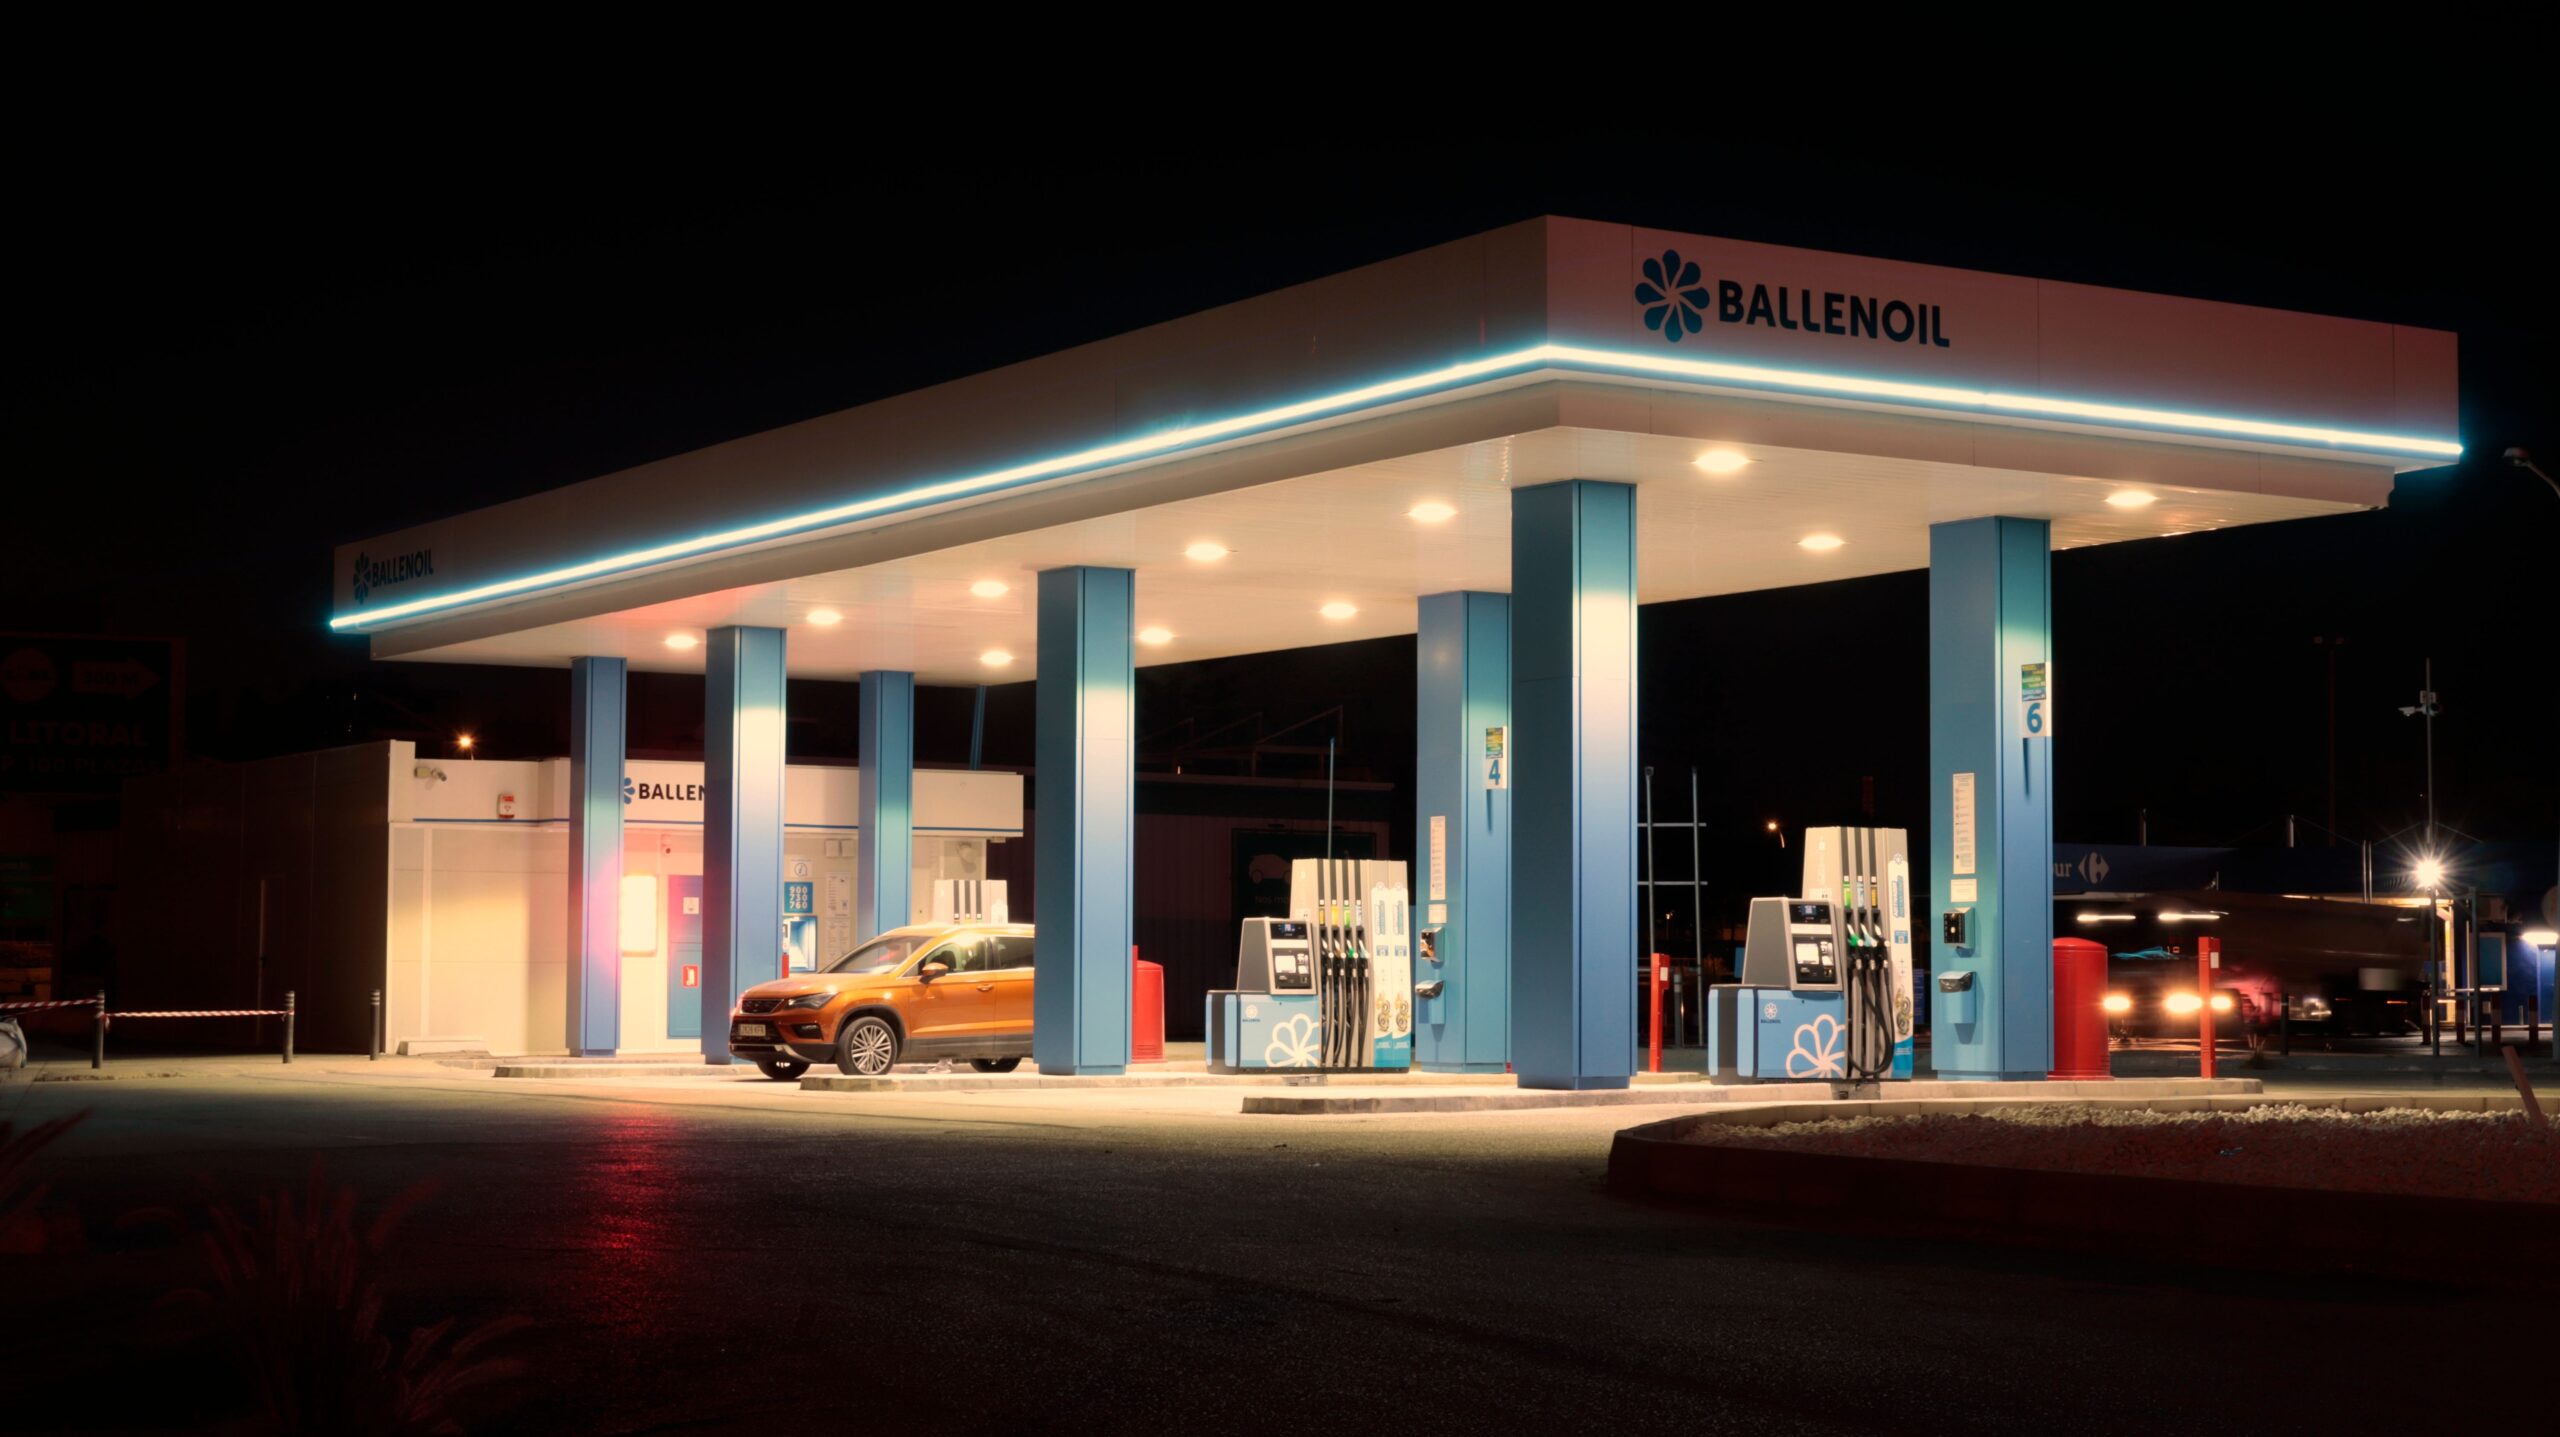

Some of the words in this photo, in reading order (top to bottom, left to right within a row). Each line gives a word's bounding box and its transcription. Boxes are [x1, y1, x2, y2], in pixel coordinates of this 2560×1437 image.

[1718, 279, 1950, 348] BALLENOIL
[371, 548, 434, 588] BALLENOIL
[2026, 702, 2043, 734] 6
[10, 720, 147, 747] LITORAL
[1488, 759, 1501, 786] 4
[2053, 863, 2073, 878] ur
[789, 886, 808, 894] 900
[789, 893, 808, 902] 730
[789, 901, 808, 910] 760
